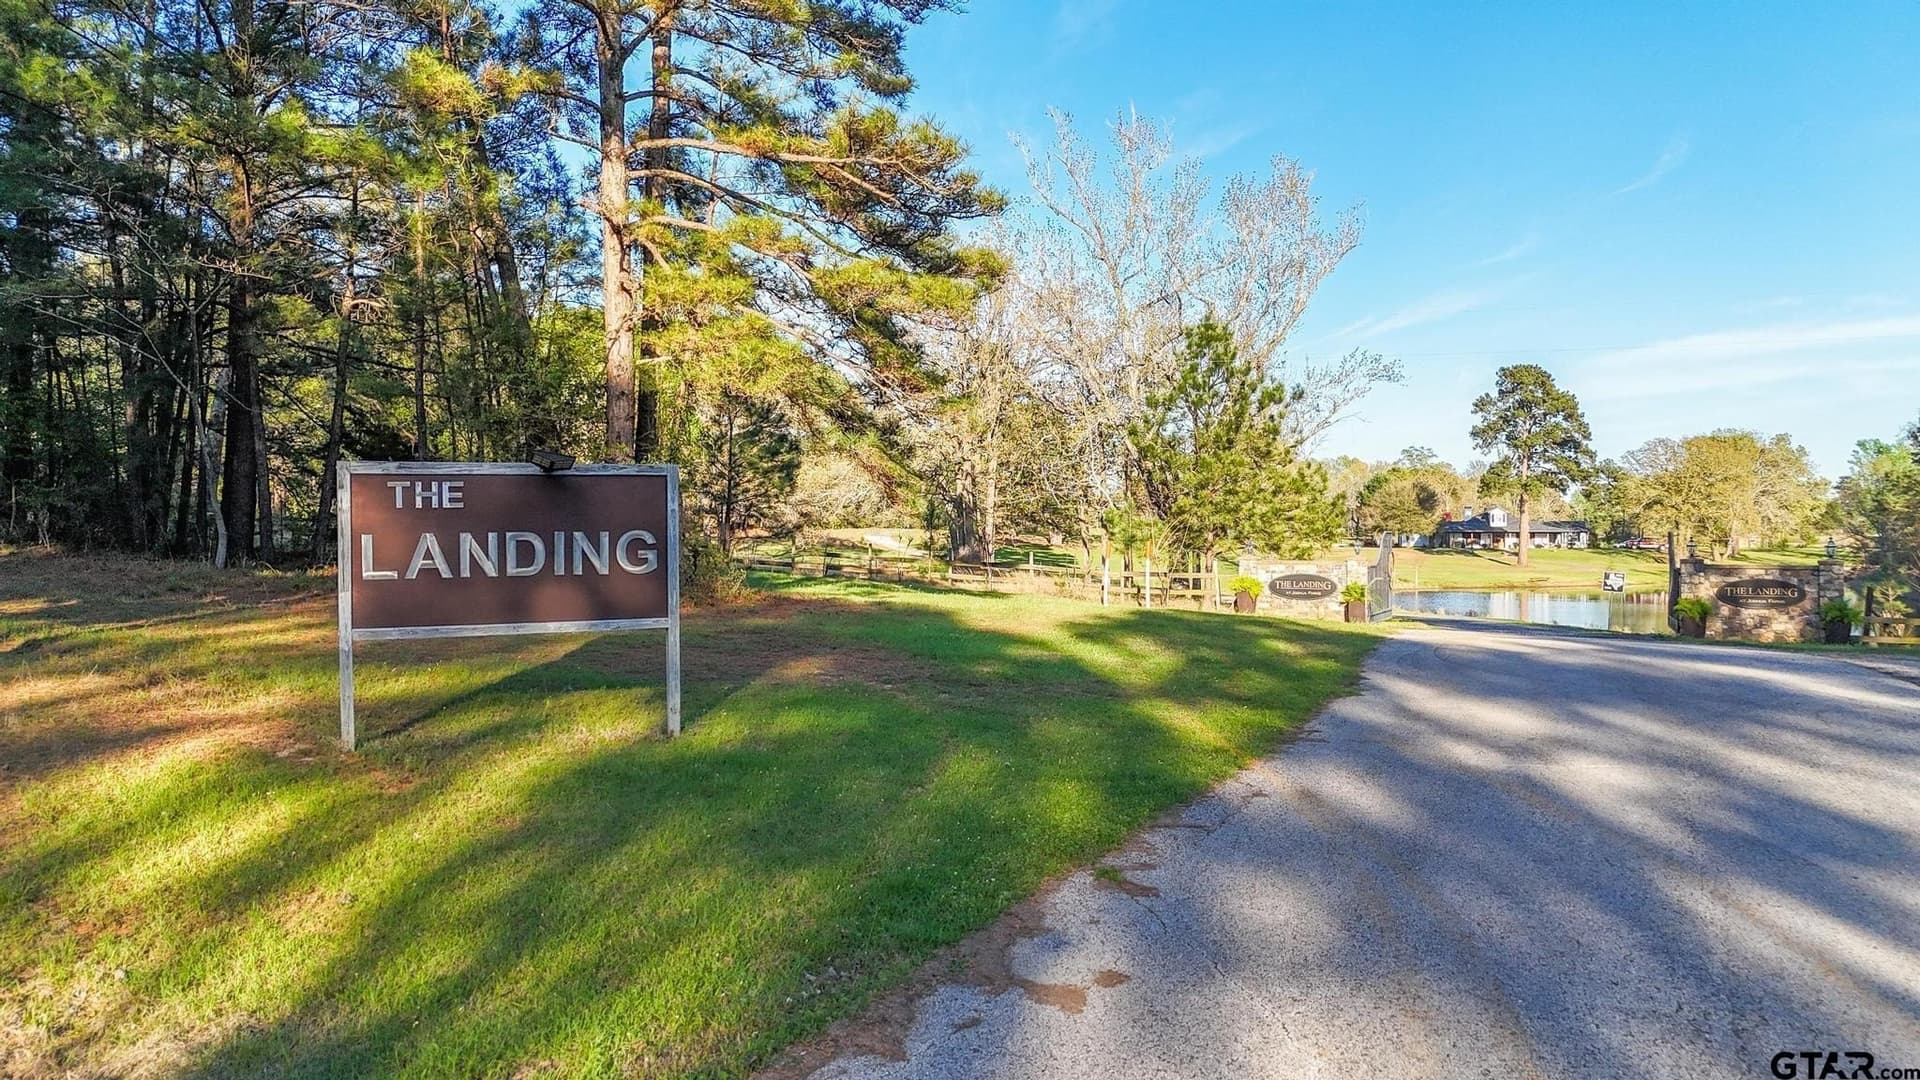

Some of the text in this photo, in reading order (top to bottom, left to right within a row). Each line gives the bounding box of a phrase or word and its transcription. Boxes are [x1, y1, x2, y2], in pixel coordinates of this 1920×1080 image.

[387, 481, 465, 509] THE
[361, 530, 658, 580] LANDING
[1275, 580, 1332, 590] THE LANDING
[1724, 587, 1798, 598] THE LANDING
